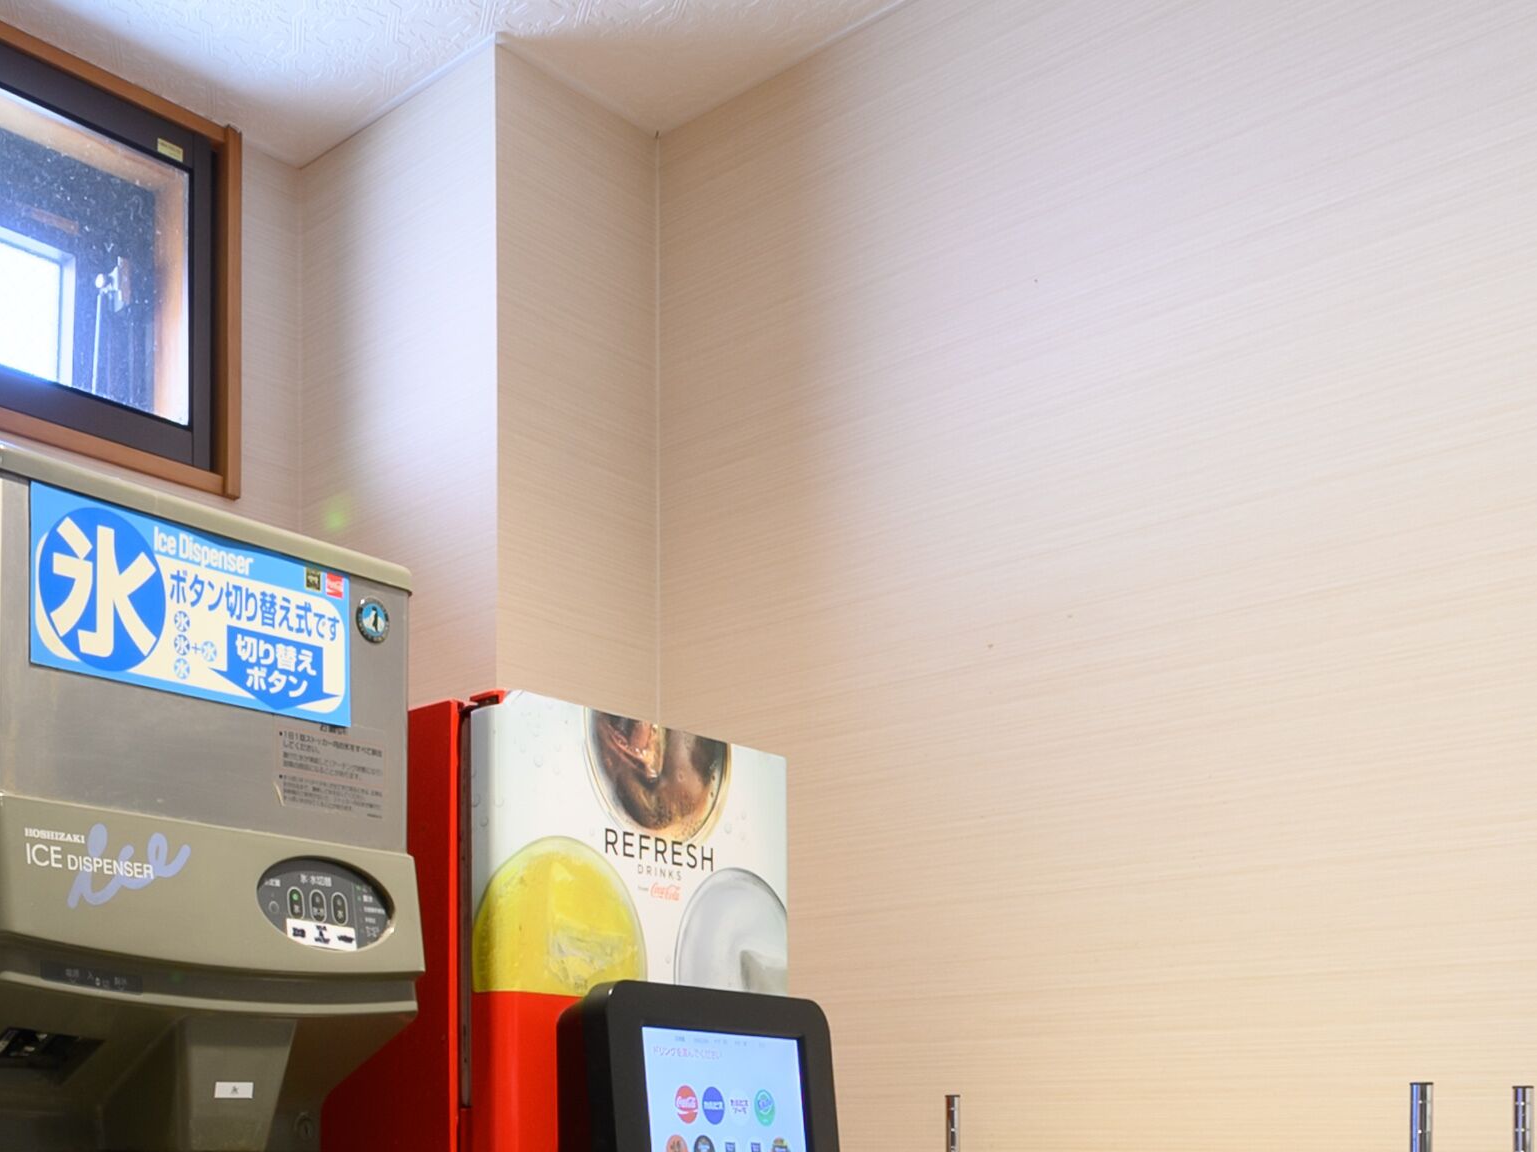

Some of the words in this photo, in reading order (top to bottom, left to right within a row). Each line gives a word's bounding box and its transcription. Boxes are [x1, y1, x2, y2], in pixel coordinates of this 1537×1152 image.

[154, 526, 176, 555] Ice
[179, 532, 254, 576] Dispenser
[50, 517, 158, 658] 氷
[170, 570, 340, 641] ボタン切り替え式です
[236, 634, 316, 675] 切り替え
[246, 666, 307, 697] ボタン
[24, 827, 85, 844] HOSHIZAKI
[605, 828, 713, 872] REFRESH
[26, 843, 62, 868] ICE
[67, 854, 154, 879] DISPENSER
[638, 864, 682, 881] DRINKS
